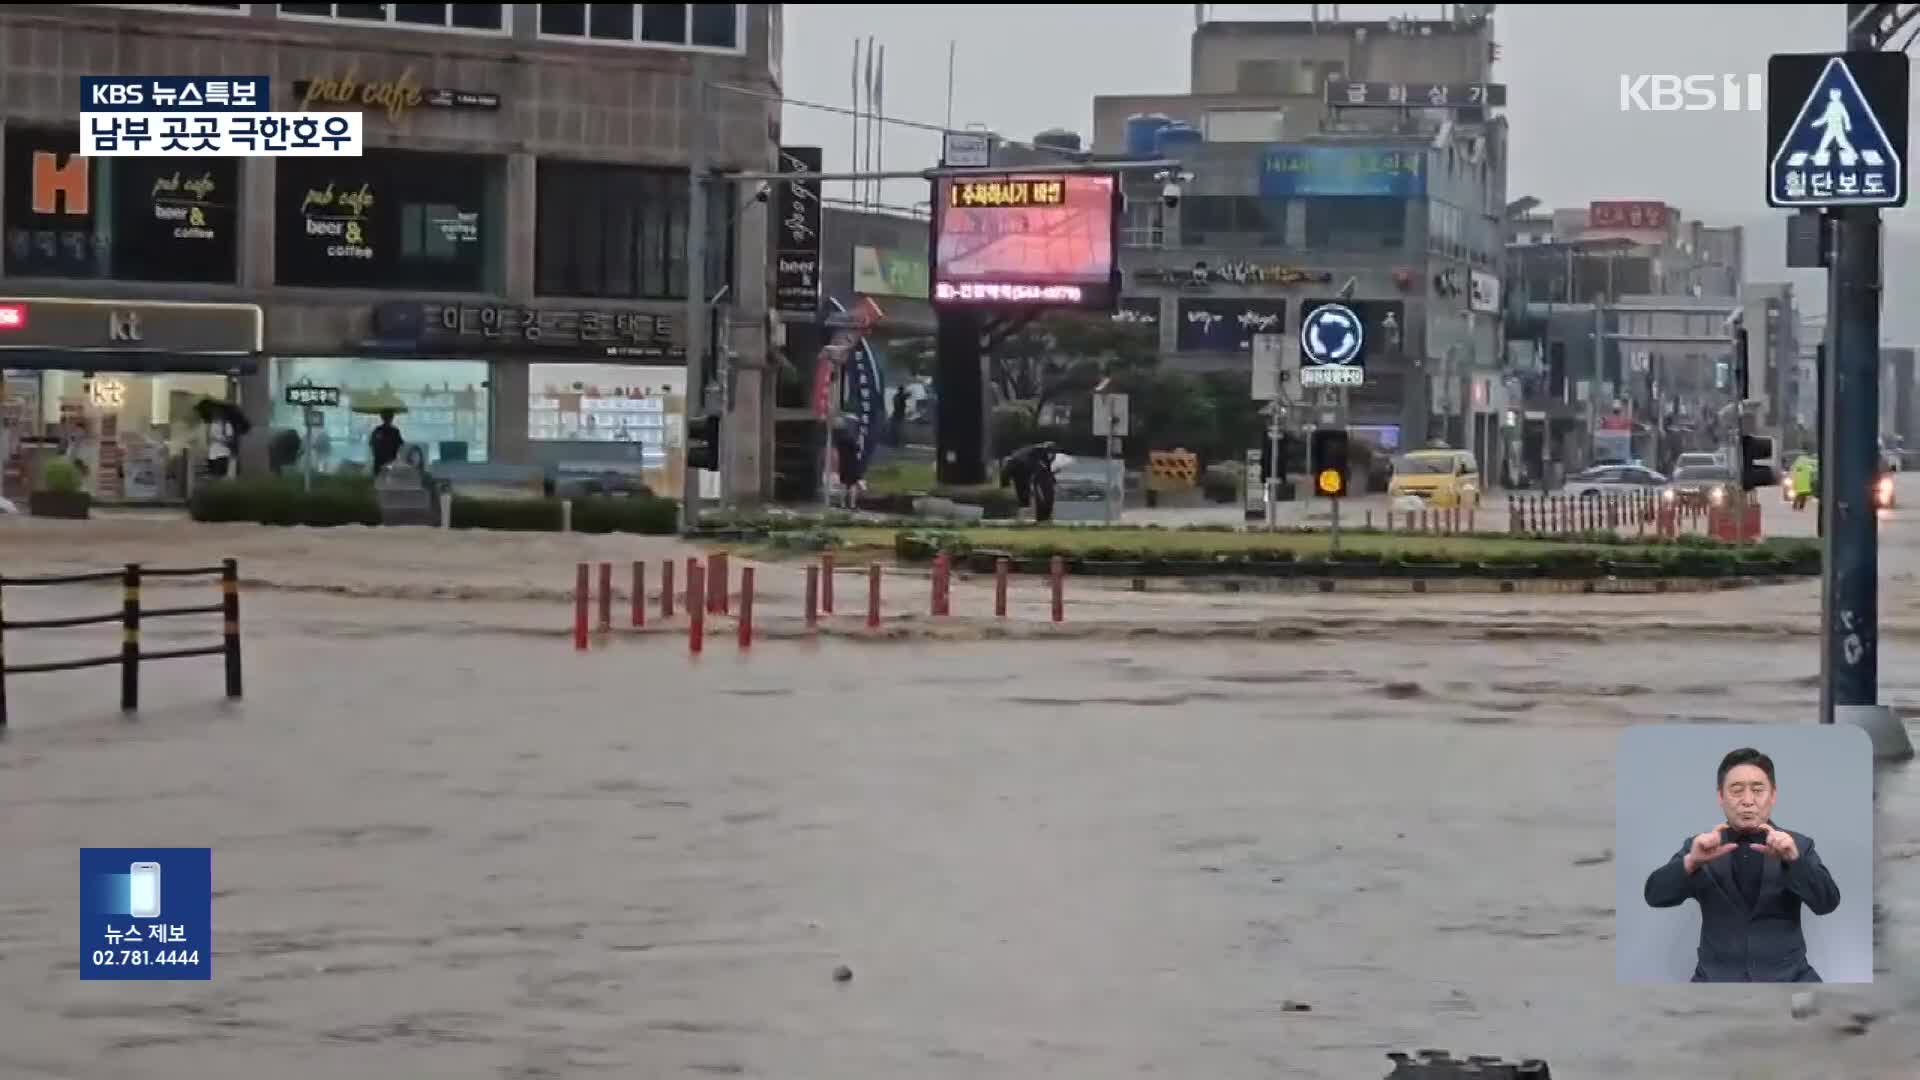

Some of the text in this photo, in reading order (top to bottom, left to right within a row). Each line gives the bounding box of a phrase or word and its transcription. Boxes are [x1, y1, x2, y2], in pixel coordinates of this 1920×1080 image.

[190, 206, 205, 226] &
[306, 217, 363, 243] beer &
[779, 259, 815, 273] beer
[109, 311, 144, 340] kt
[91, 378, 126, 407] kt
